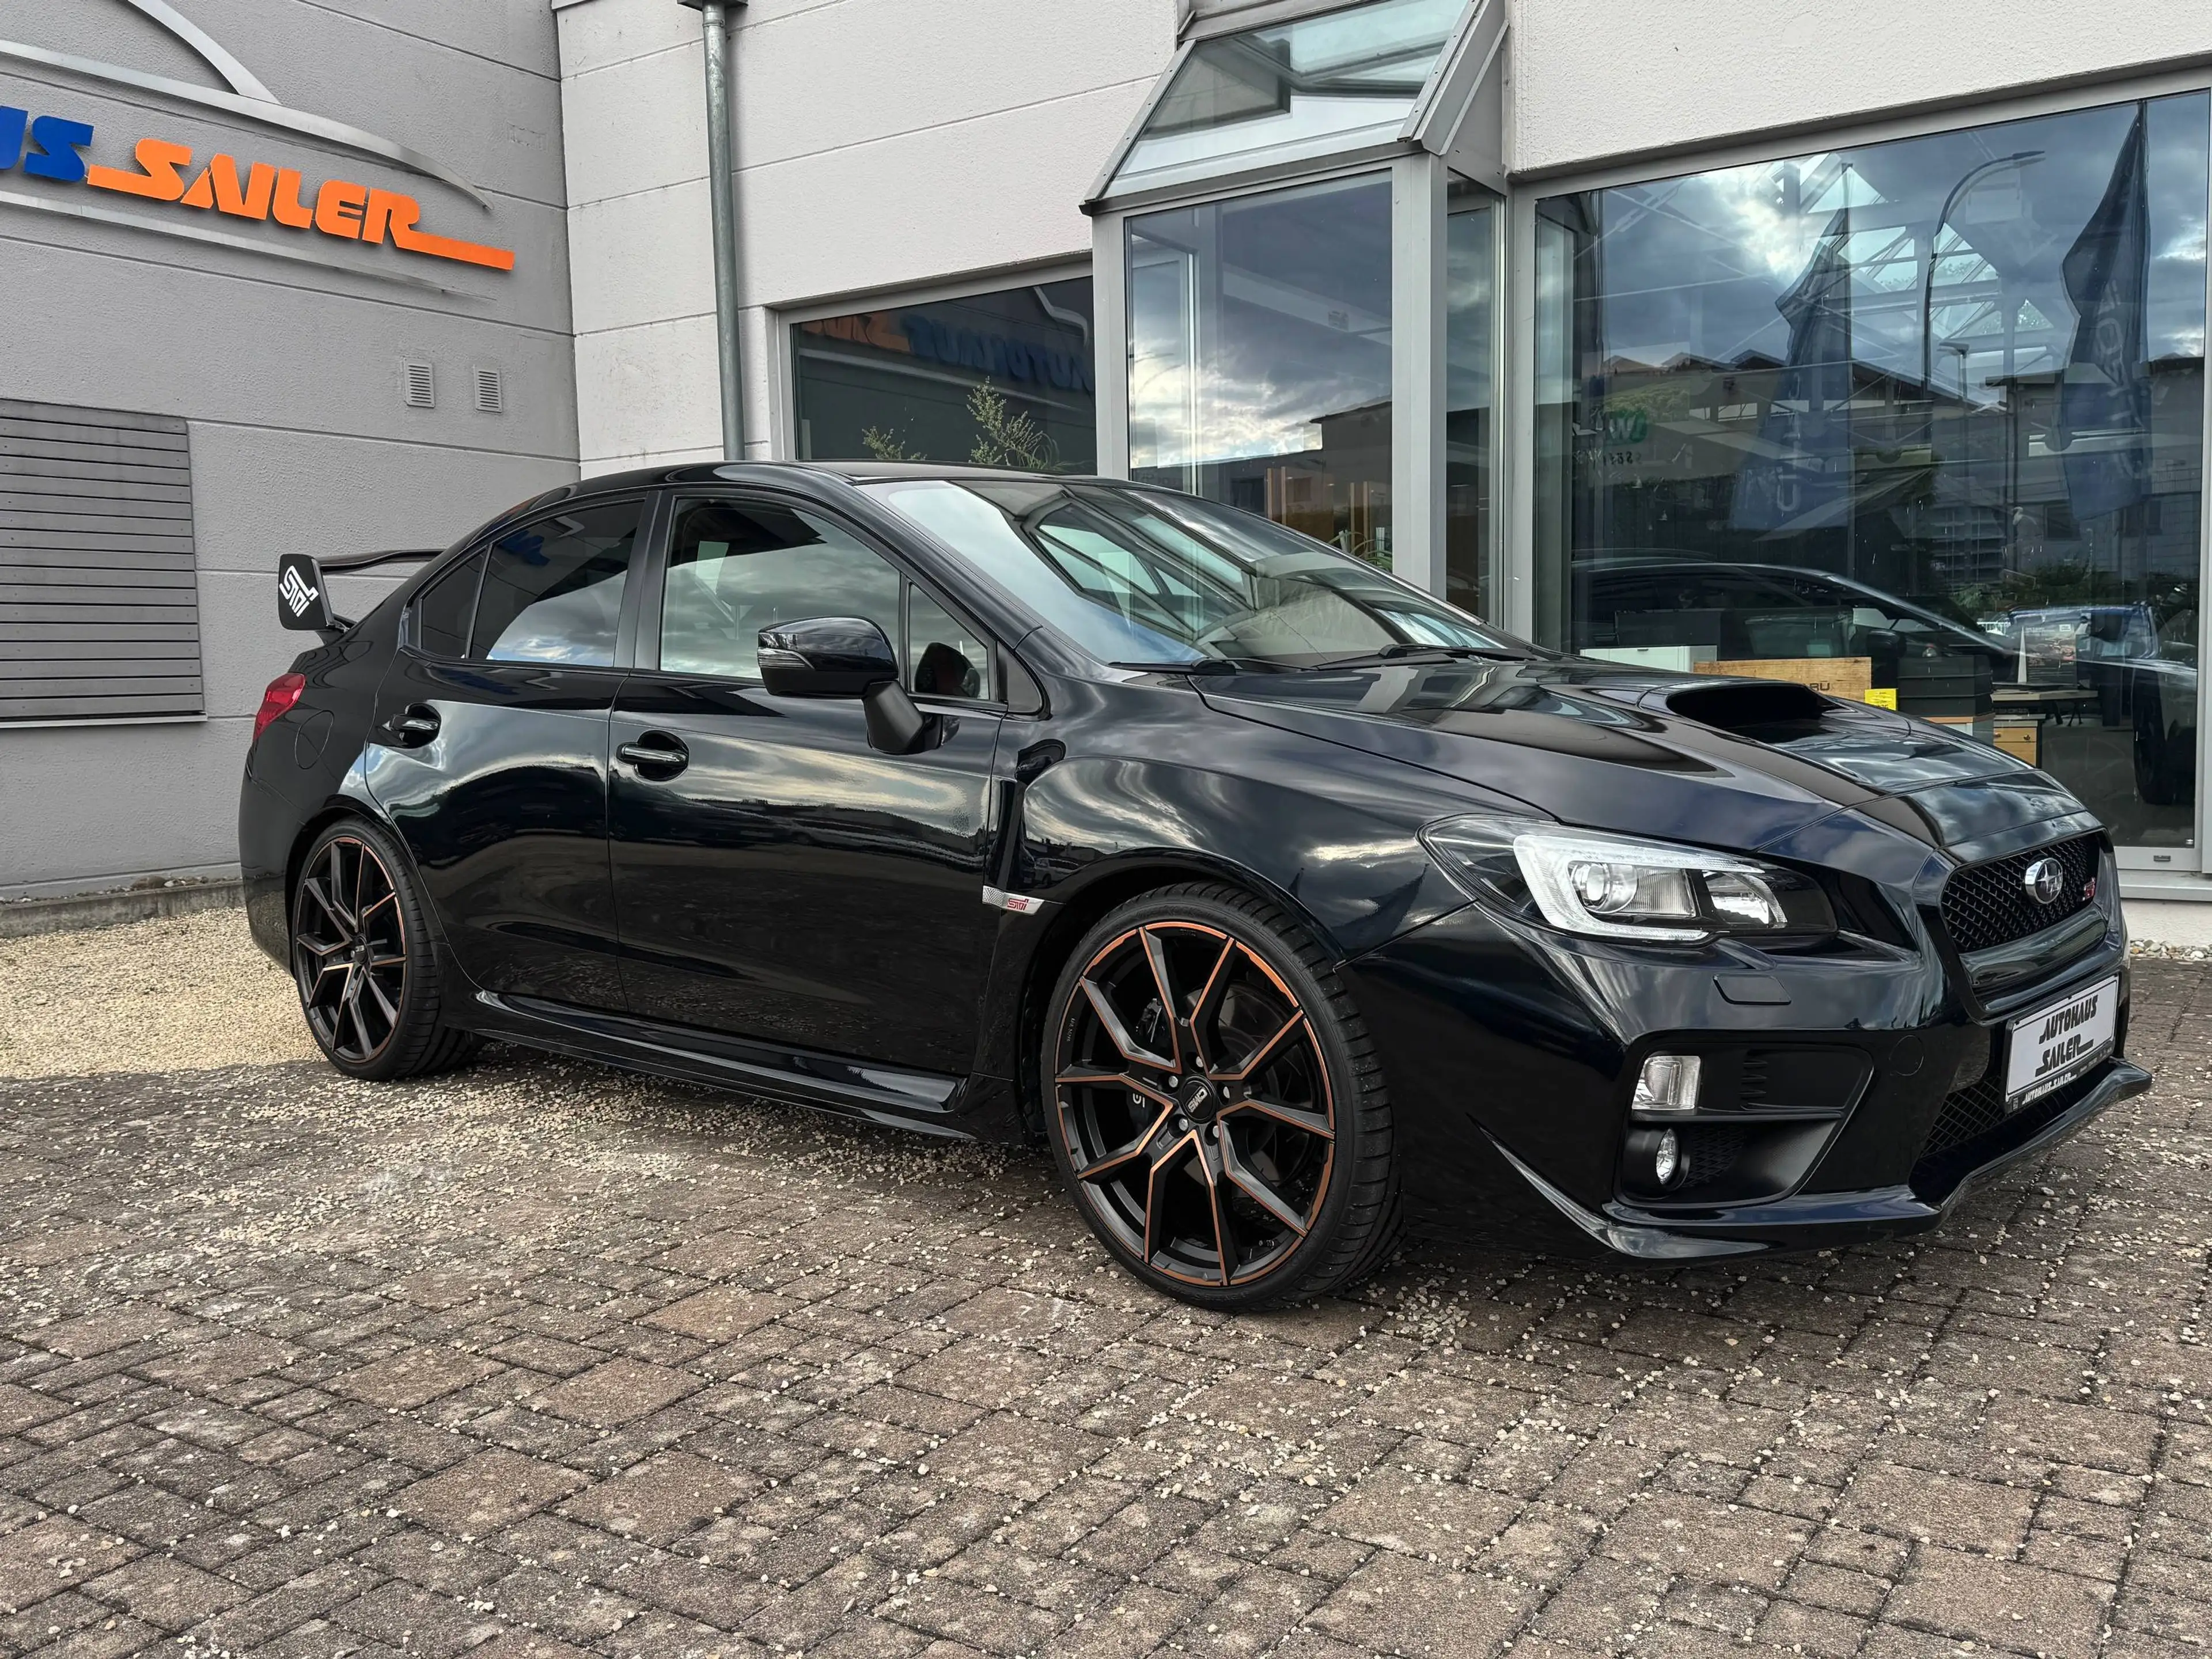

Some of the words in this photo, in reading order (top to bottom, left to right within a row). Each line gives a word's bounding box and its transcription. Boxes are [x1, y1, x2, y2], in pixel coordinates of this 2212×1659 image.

[87, 138, 514, 271] SAILER
[2038, 994, 2099, 1045] AUTOHAUS
[2035, 1033, 2094, 1077] SAILER
[2022, 1081, 2052, 1105] AUTOHAUS
